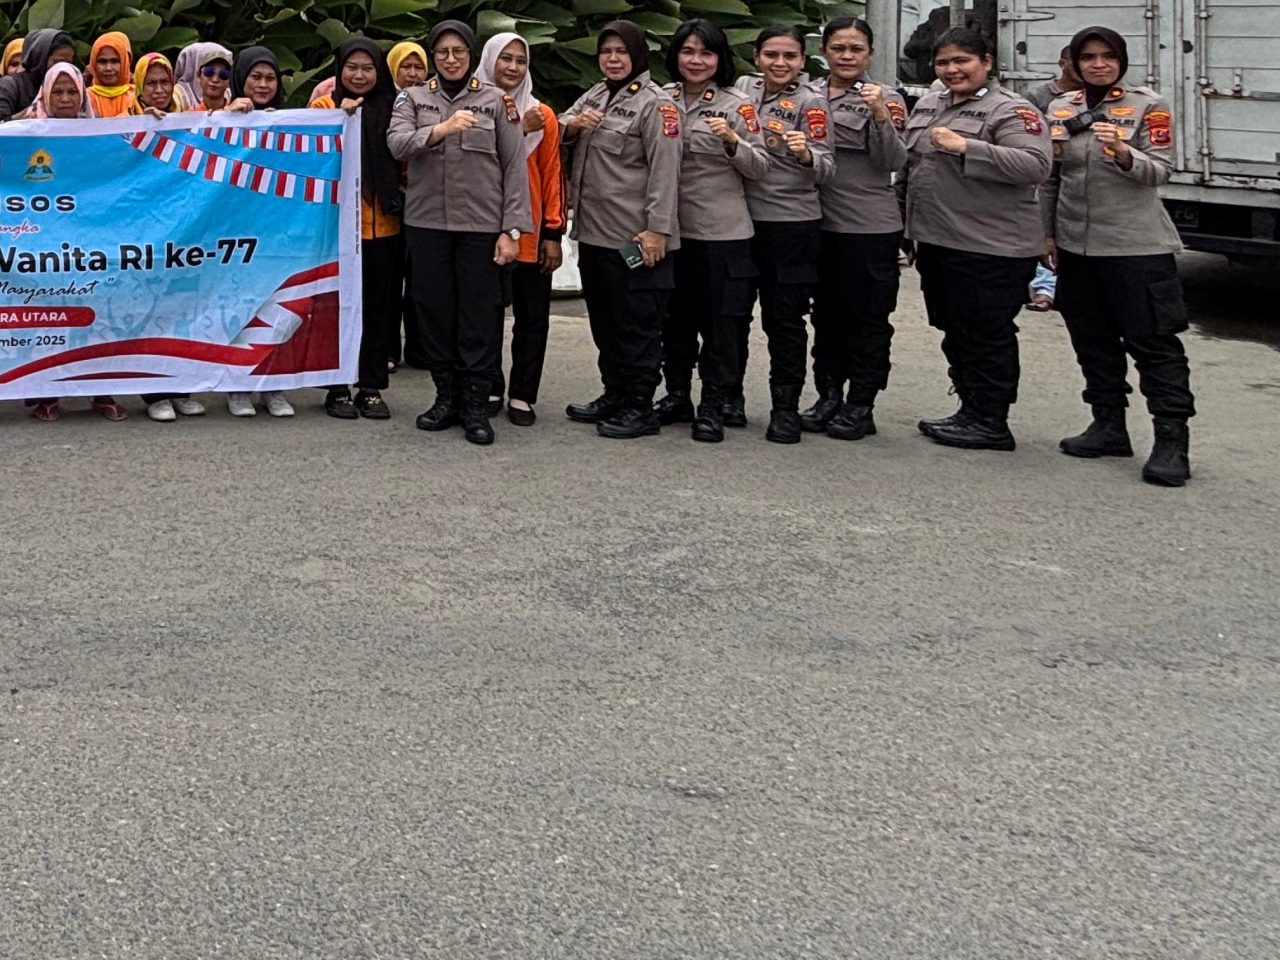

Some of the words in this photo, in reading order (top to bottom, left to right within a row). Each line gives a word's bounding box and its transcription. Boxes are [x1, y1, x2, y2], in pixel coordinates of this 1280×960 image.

[463, 105, 495, 117] POLRI
[611, 106, 638, 119] POLRI
[698, 109, 729, 120] POLRI
[768, 107, 797, 122] POLRI
[837, 102, 870, 115] POLRI
[958, 109, 987, 119] POLRI
[119, 244, 153, 271] RI
[165, 237, 258, 269] ke-77
[22, 311, 68, 323] UTARA
[35, 335, 66, 346] 2025
